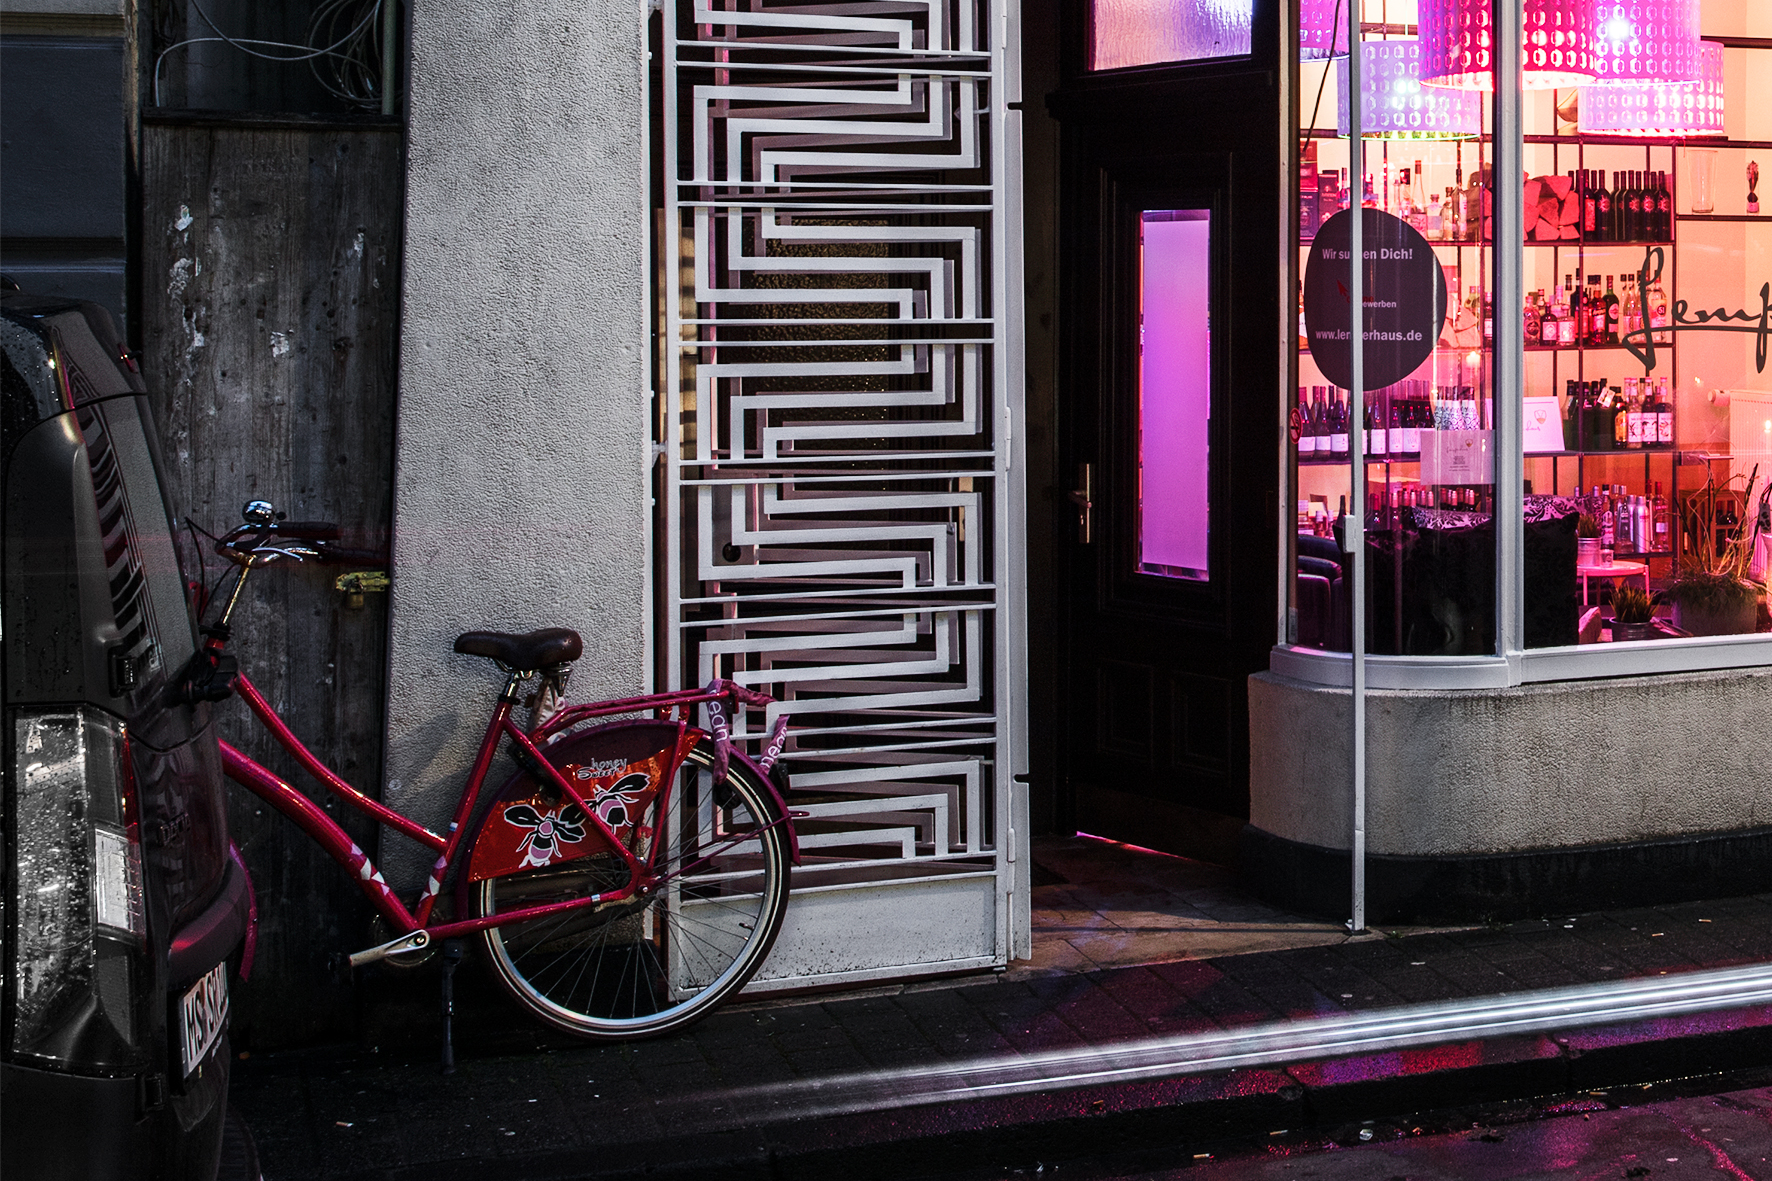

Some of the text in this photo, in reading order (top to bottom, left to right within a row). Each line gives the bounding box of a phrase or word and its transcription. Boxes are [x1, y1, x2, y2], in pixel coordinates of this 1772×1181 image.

[1322, 248, 1413, 260] Wir suen Dich!
[591, 757, 627, 774] honey
